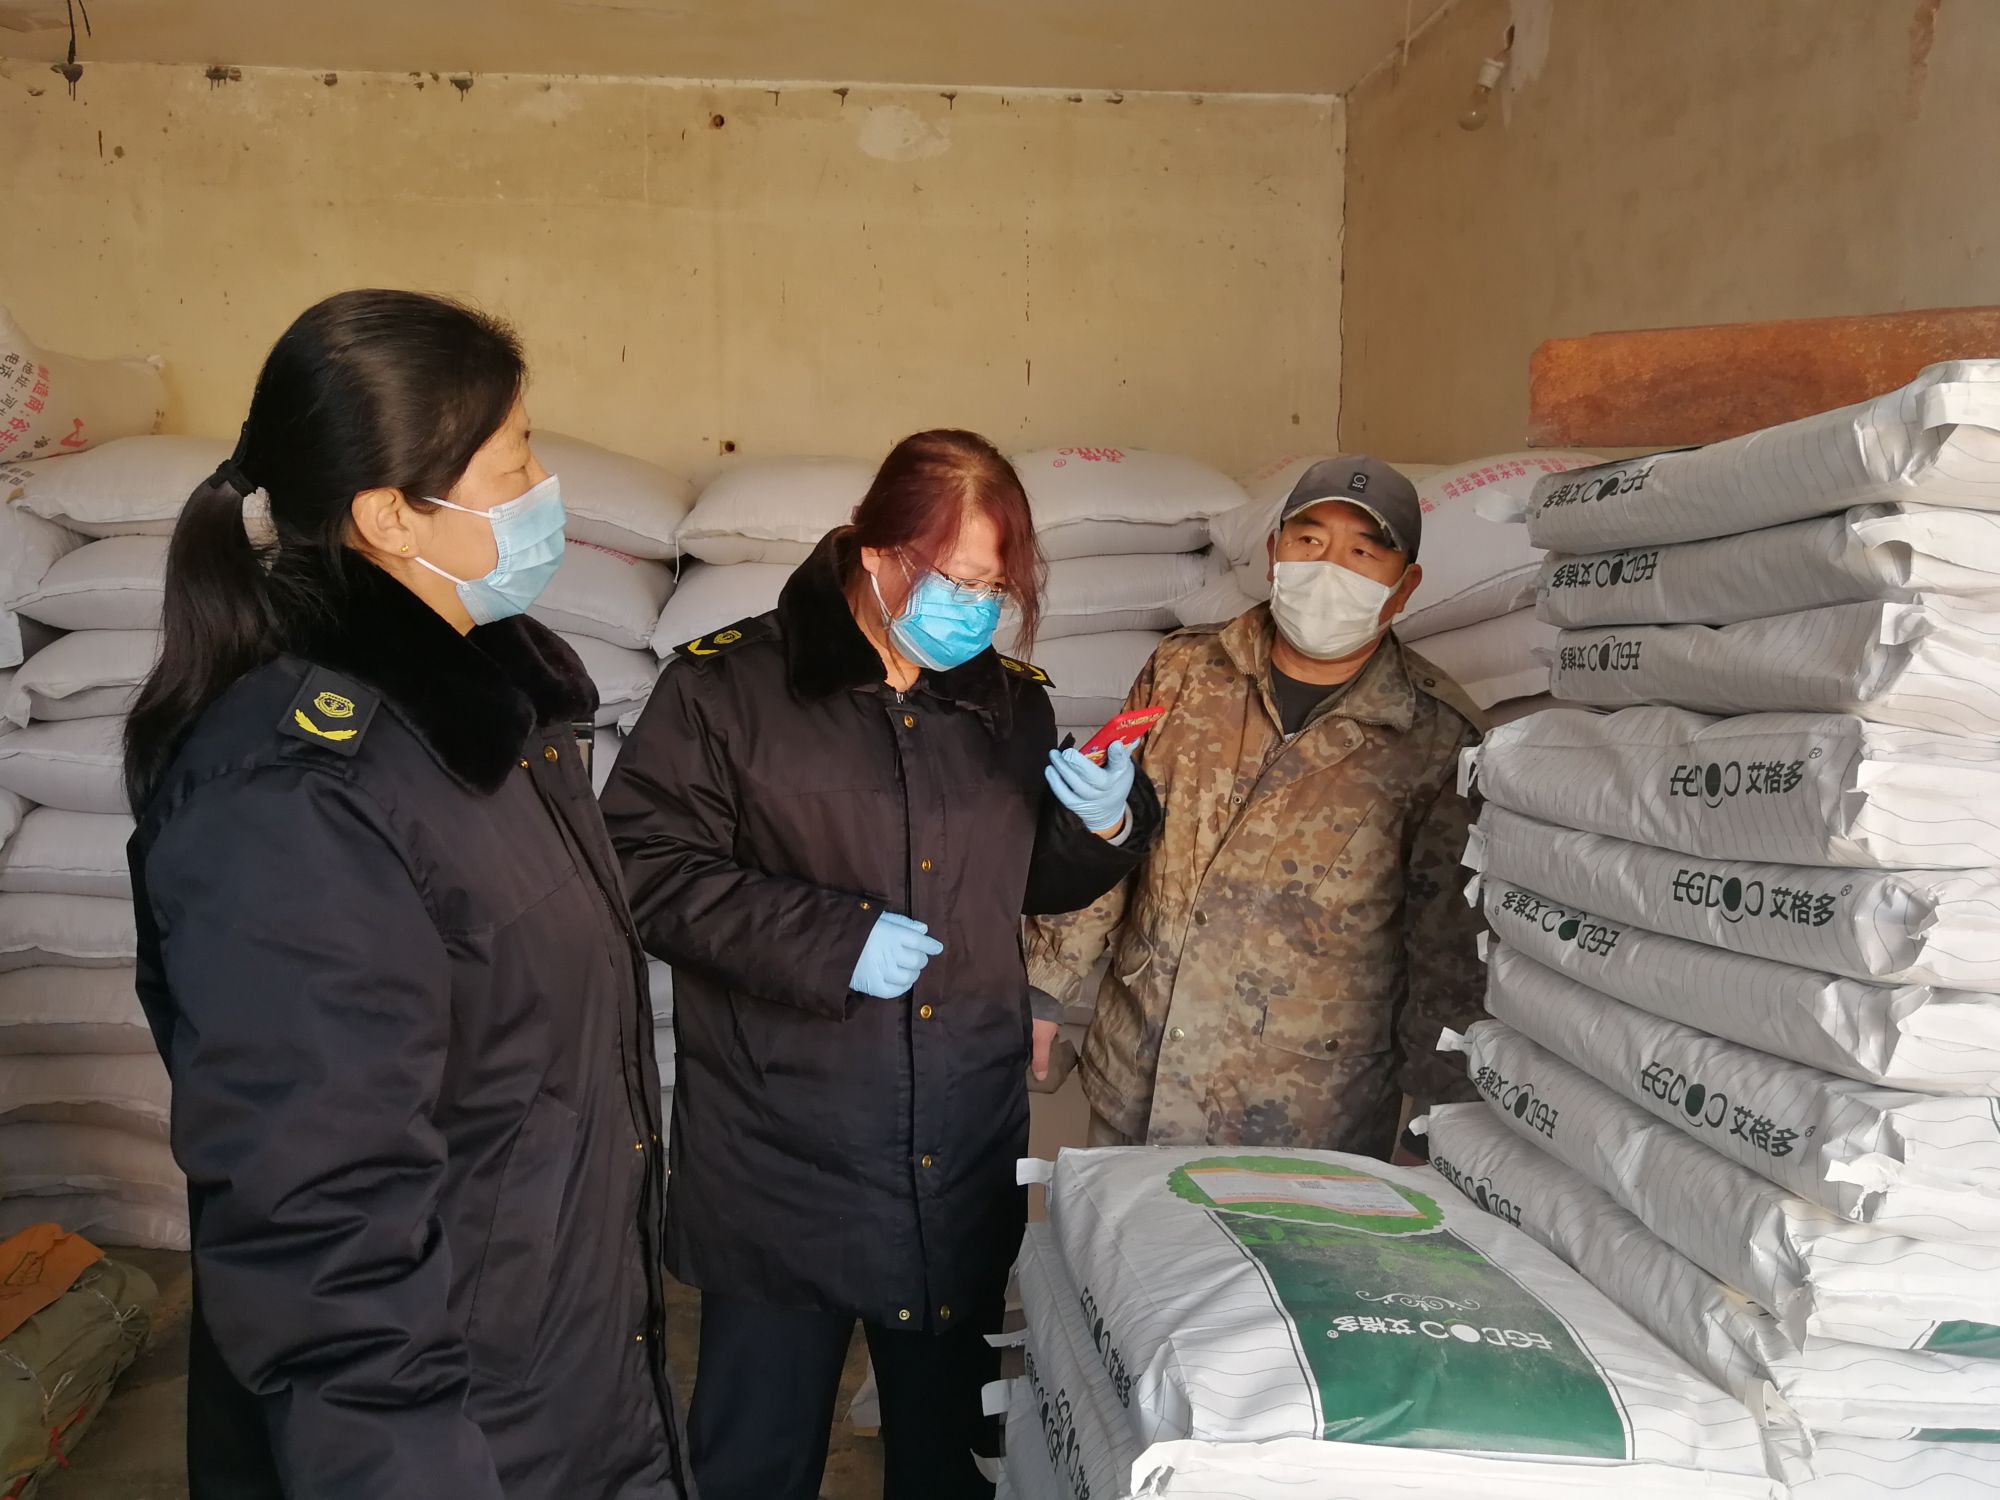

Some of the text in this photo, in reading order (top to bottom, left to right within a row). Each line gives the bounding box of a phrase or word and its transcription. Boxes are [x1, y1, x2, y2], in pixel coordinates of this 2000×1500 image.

[1552, 562, 1594, 589] 艾格多
[1560, 646, 1586, 671] 艾格多
[1745, 760, 1806, 794] 艾格多
[1502, 891, 1549, 924] 艾格多
[1769, 887, 1837, 926] 艾格多
[1474, 1066, 1509, 1101] 艾格多
[1730, 1106, 1800, 1157] 艾格多
[1331, 1315, 1416, 1335] 艾格多
